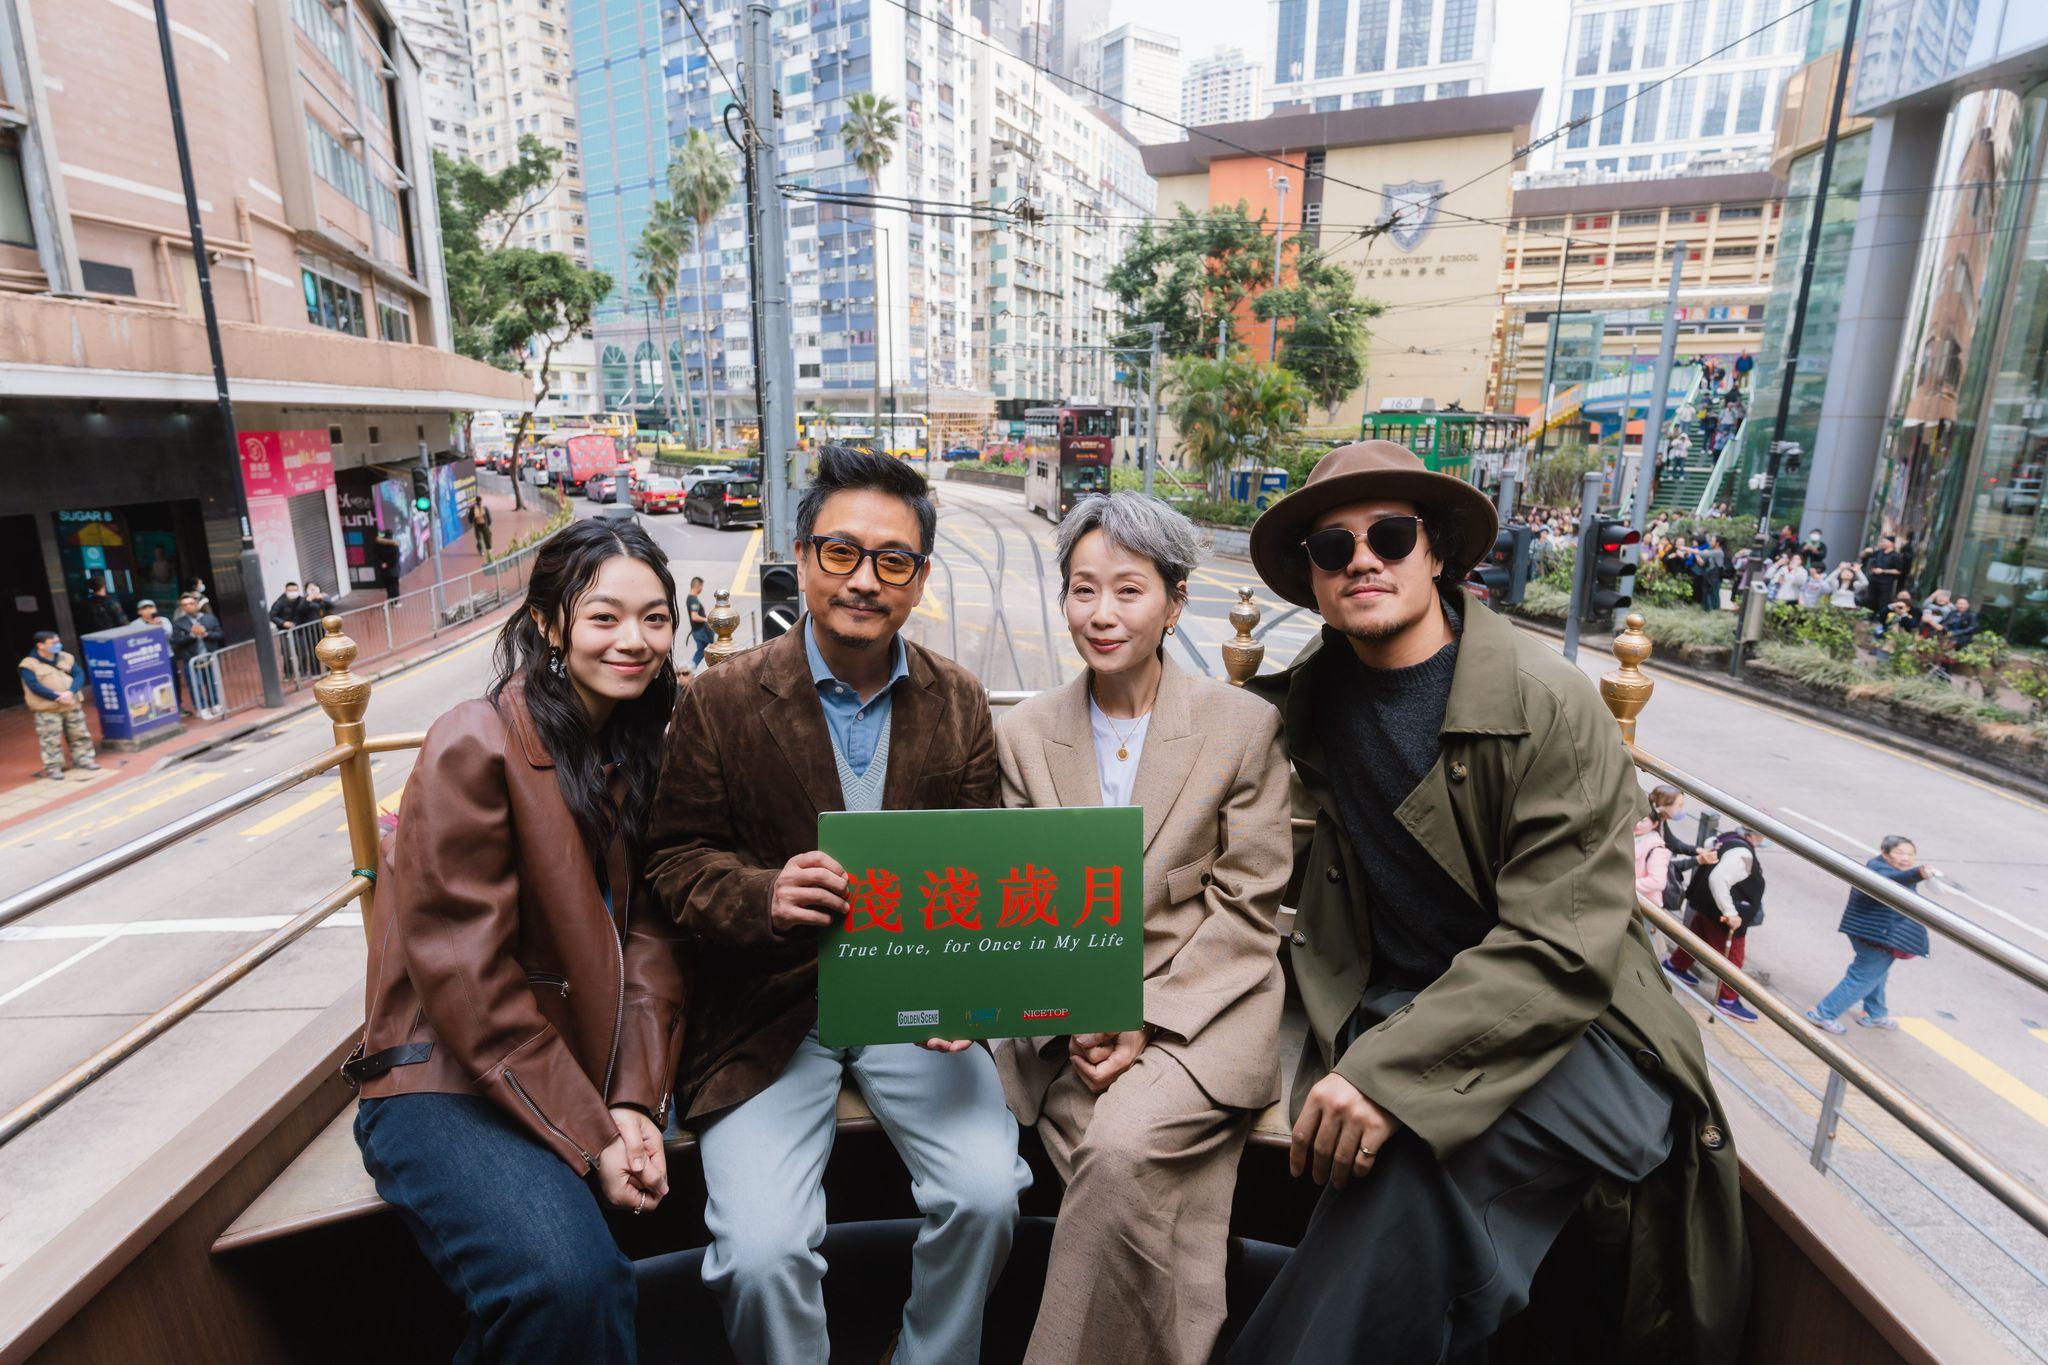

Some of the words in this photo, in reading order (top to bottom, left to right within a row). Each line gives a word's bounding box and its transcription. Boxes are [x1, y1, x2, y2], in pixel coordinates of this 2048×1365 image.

[1388, 256, 1433, 265] CONVENT
[1439, 254, 1479, 263] SCHOOL
[1391, 399, 1413, 409] 160
[58, 510, 103, 522] SUGAR
[843, 863, 1124, 933] 淺淺歲月
[838, 943, 878, 958] True
[886, 941, 931, 956] love,
[943, 939, 972, 954] for
[978, 937, 1022, 952] Once
[1029, 935, 1047, 950] in
[1053, 934, 1081, 952] My
[1088, 932, 1125, 948] Life
[1023, 1008, 1069, 1019] NICETOP
